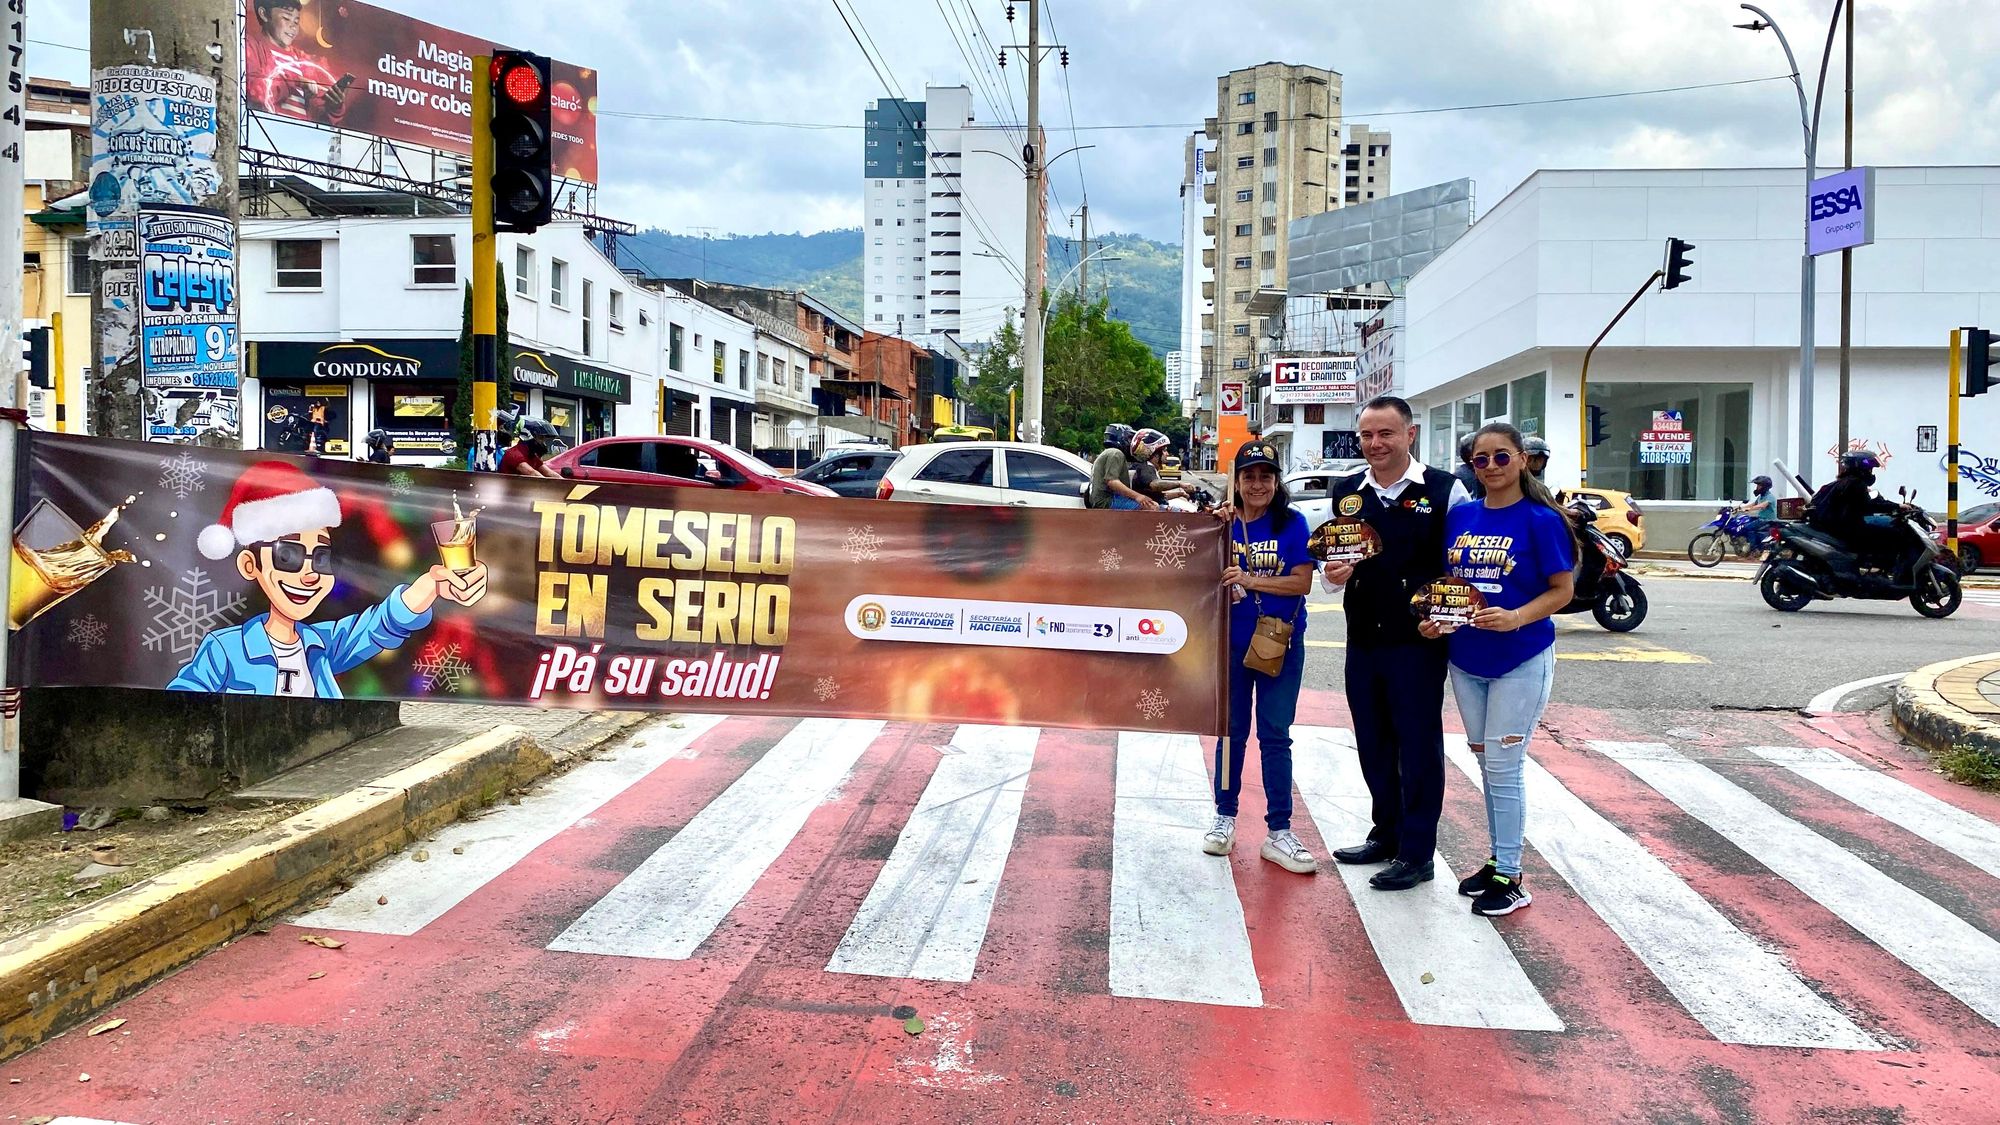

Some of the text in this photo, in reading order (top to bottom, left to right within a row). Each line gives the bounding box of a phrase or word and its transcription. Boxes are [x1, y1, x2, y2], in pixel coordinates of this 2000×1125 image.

[417, 39, 472, 72] Magia
[171, 72, 184, 81] EN
[378, 53, 473, 95] disfrutar la
[368, 78, 428, 107] mayor
[169, 101, 210, 119] NIÑOS
[551, 95, 577, 111] Claro
[173, 114, 209, 129] 5.000
[568, 135, 584, 144] TODO
[1811, 185, 1862, 221] ESSA
[153, 222, 172, 236] FELIZ
[173, 221, 185, 233] 50
[186, 236, 205, 246] DEL
[145, 243, 192, 255] FABULOSO
[144, 315, 182, 327] VICTOR
[149, 336, 197, 356] METROPOLITANO
[205, 325, 226, 361] 9
[152, 356, 161, 364] DE
[313, 361, 418, 377] CONDUSAN
[1310, 371, 1346, 381] GRANITOS
[147, 376, 182, 386] INFORMES:
[513, 366, 559, 388] CONDUSAN
[1641, 452, 1690, 463] 3108649079
[1415, 506, 1432, 514] FND
[533, 484, 796, 576] TÓMESELO
[1325, 534, 1361, 545] EN SERIO
[1453, 531, 1513, 549] TÓMESELO
[1448, 548, 1507, 565] EN SERIO
[1464, 568, 1474, 578] su
[1475, 566, 1501, 579] salud!
[1431, 594, 1470, 606] EN SERIO
[535, 571, 791, 646] EN SERIO
[890, 610, 943, 619] GOBERNACIÓN
[970, 614, 1011, 622] SECRETARÍA
[890, 616, 1022, 633] SANTANDER HACIENDA
[1050, 621, 1065, 633] FND
[530, 644, 780, 699] ¡Pá su salud!
[278, 668, 300, 694] T
